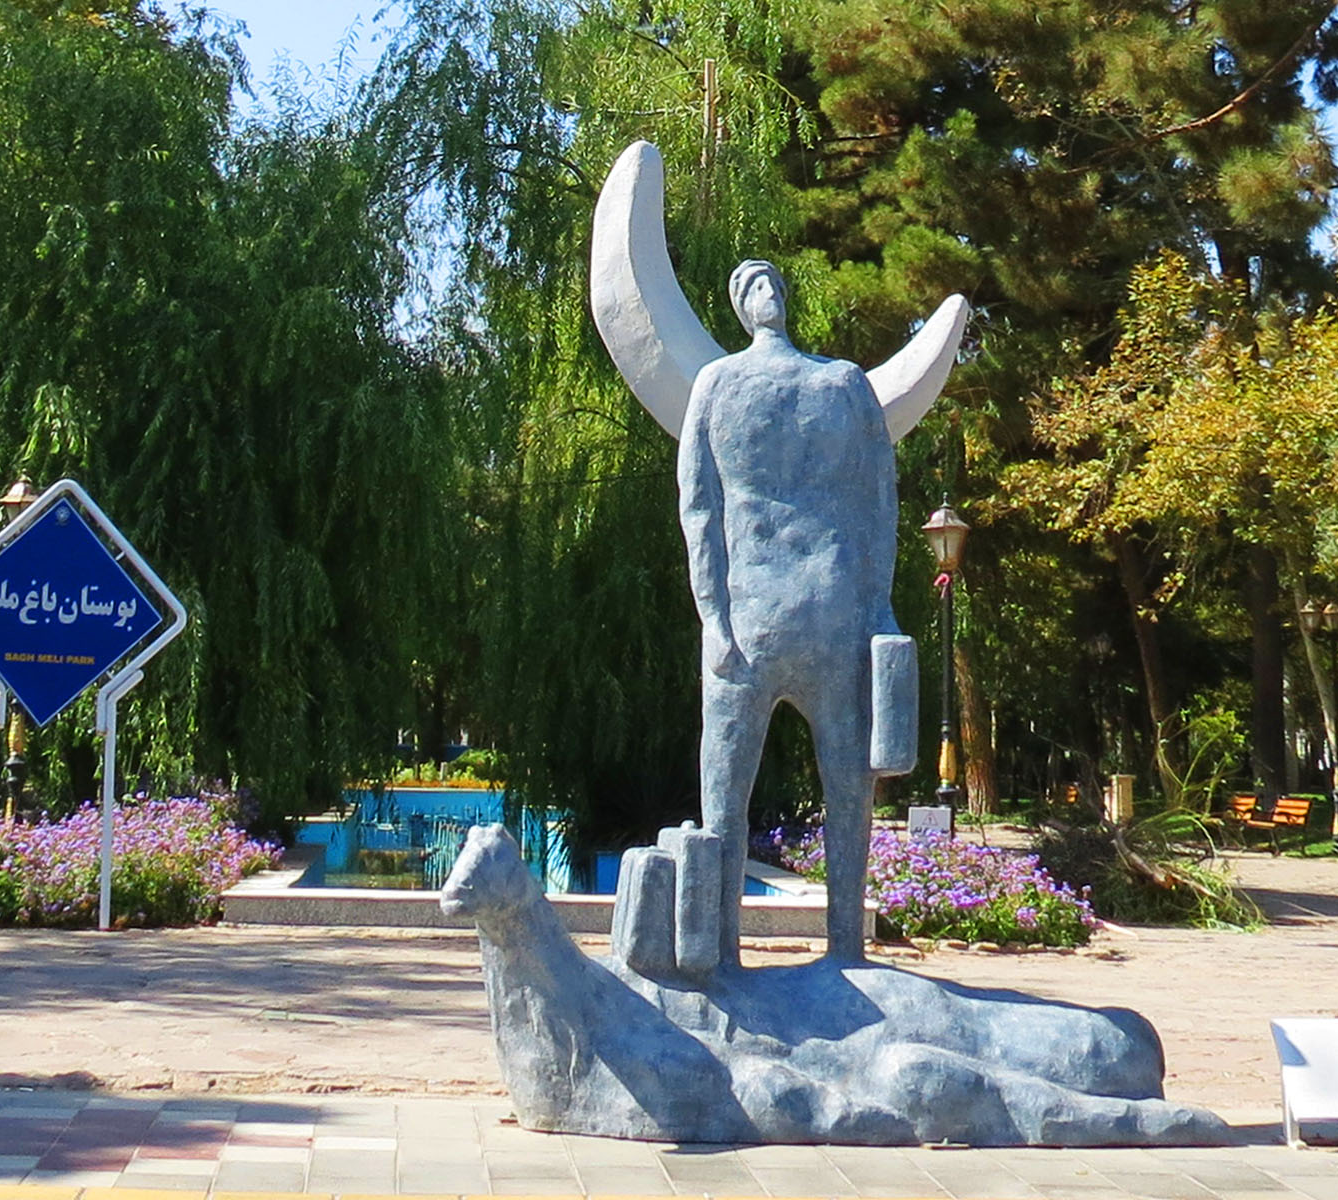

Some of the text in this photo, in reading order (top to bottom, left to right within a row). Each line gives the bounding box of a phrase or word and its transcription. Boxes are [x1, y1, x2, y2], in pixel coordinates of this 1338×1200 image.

[19, 579, 57, 625] باغ
[58, 584, 137, 631] بوستان
[66, 655, 96, 665] PARK
